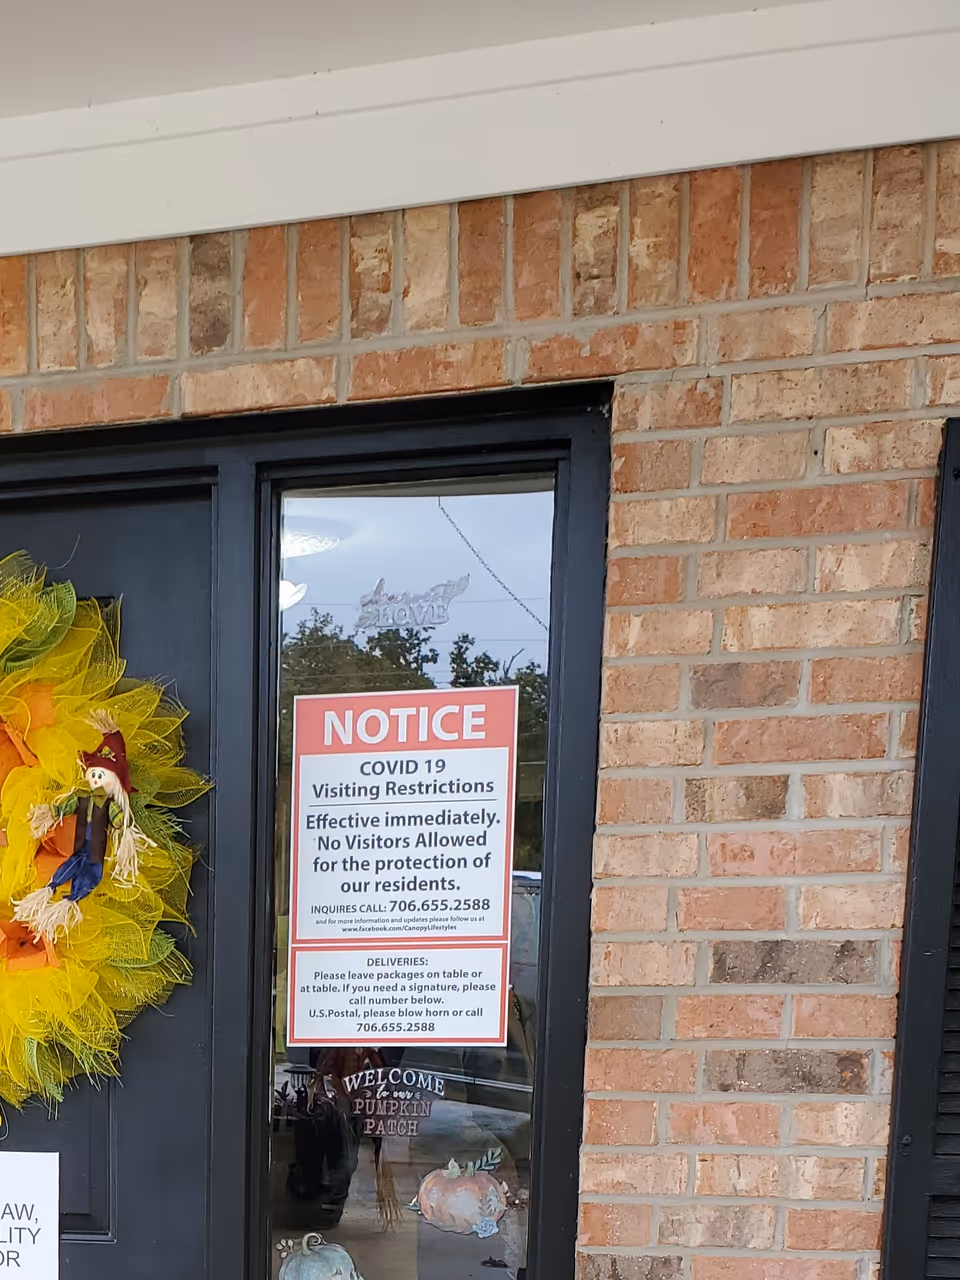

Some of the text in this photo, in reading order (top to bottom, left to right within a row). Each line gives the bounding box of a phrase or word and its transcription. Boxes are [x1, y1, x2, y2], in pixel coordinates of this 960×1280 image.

[323, 703, 485, 745] NOTICE
[359, 758, 445, 776] COVID 19
[312, 778, 494, 800] Visiting Restrictions
[306, 808, 500, 829] Effective immediately.
[318, 830, 487, 851] No Visitors Allowed
[312, 851, 491, 874] for the protection of
[340, 875, 460, 893] our residents.
[310, 898, 490, 915] INQUIRES CALL: 706.655.2588
[403, 916, 428, 924] updates
[366, 956, 428, 966] DELIVERIES:
[313, 970, 345, 980] Please
[347, 970, 374, 979] leave
[376, 969, 424, 981] packages
[442, 968, 468, 978] table
[300, 984, 310, 993] at
[312, 983, 340, 992] table.
[342, 983, 350, 992] If
[351, 985, 370, 994] you
[372, 982, 398, 992] need
[408, 982, 459, 993] signature,
[462, 981, 496, 993] please
[348, 995, 444, 1005] call number below.
[308, 1008, 360, 1018] U.S.Postal,
[363, 1008, 395, 1019] please
[398, 1007, 423, 1017] blow
[425, 1007, 449, 1016] horn
[465, 1007, 483, 1016] call
[356, 1022, 435, 1032] 706.655.2588
[343, 1068, 445, 1096] WELCOME
[376, 1084, 414, 1099] to our
[353, 1099, 432, 1117] PUMPKIN
[364, 1119, 419, 1136] PATCH
